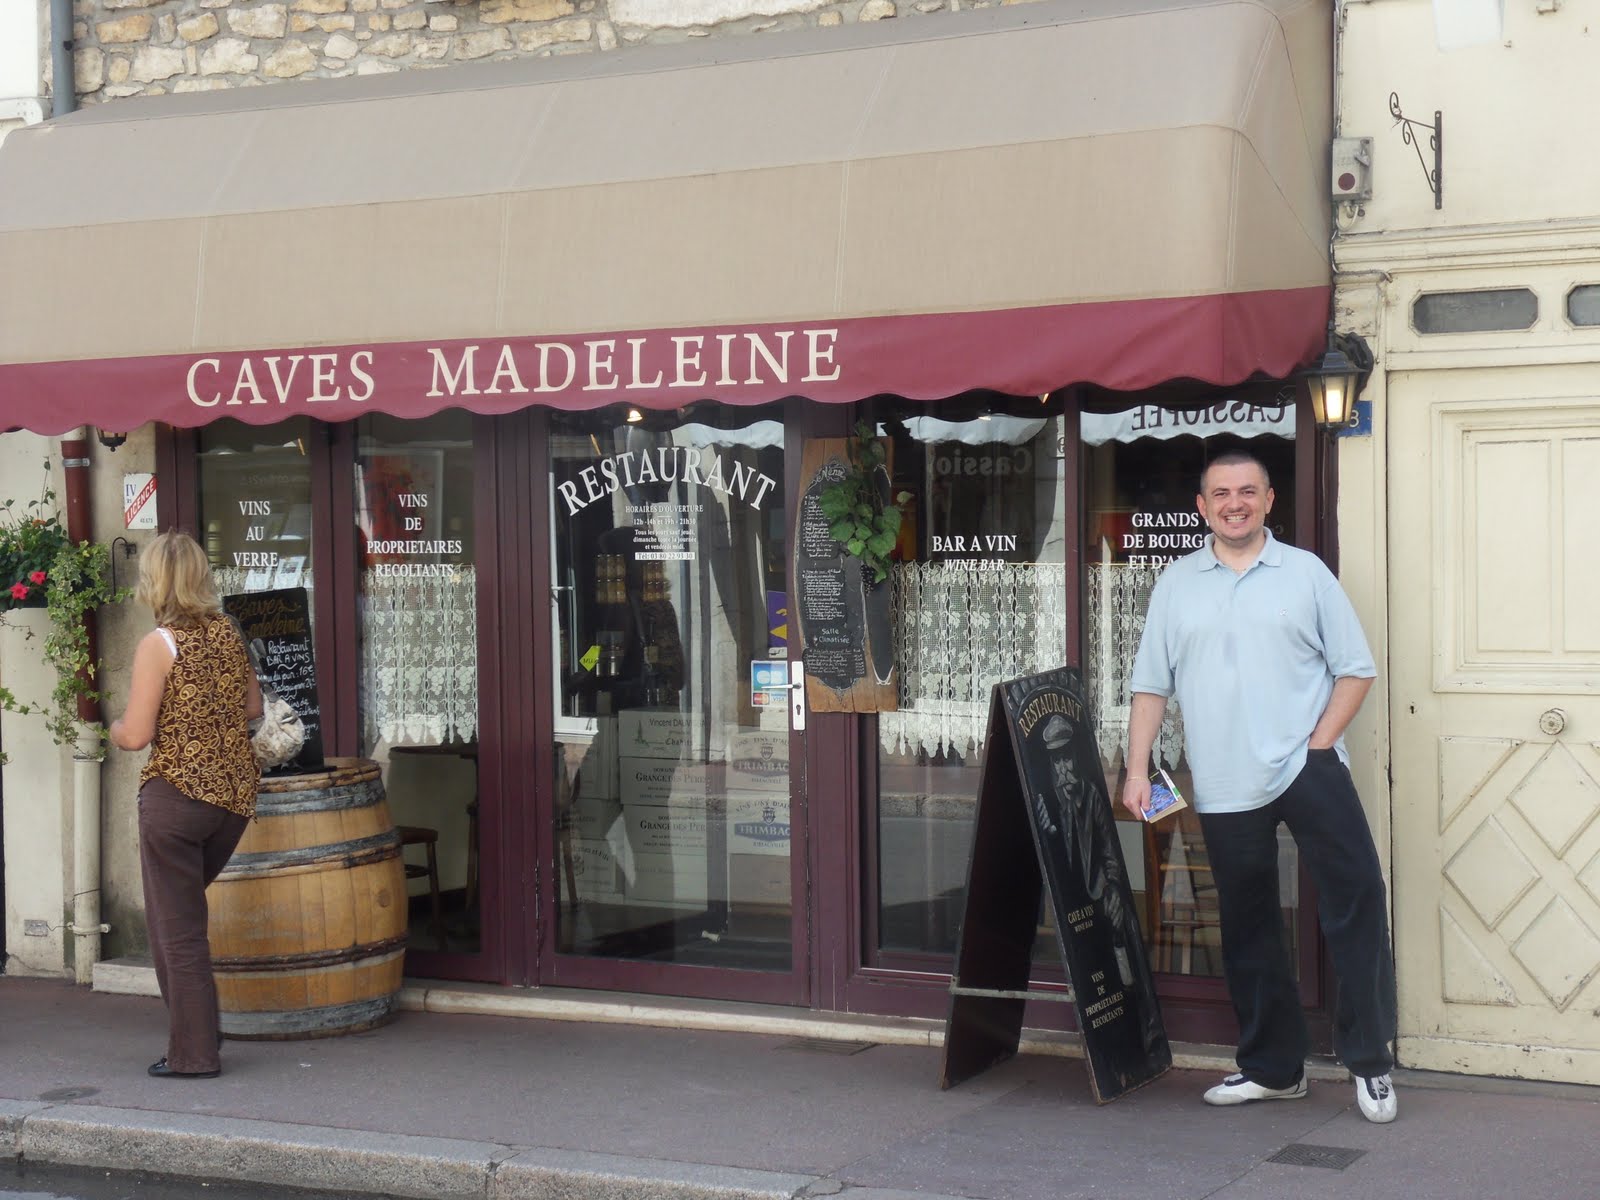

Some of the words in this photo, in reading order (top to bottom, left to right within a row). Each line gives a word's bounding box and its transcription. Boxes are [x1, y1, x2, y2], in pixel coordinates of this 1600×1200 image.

[186, 351, 376, 408] CAVES
[425, 329, 841, 398] MADELEINE
[557, 447, 777, 516] RESTAURANT
[126, 484, 136, 497] IV
[126, 480, 155, 524] LICENCE
[239, 501, 271, 516] VINS
[398, 494, 428, 508] VINS
[625, 505, 658, 513] HORAIRES
[658, 504, 704, 513] D'OUVERTURE
[404, 517, 423, 531] DE
[1131, 512, 1200, 528] GRANDS
[245, 526, 264, 541] AU
[1123, 533, 1145, 549] DE
[1148, 533, 1206, 549] BOURG
[366, 540, 463, 554] PROPRIETAIRES
[932, 535, 966, 552] BAR
[970, 535, 982, 552] A
[985, 534, 1018, 552] VIN
[233, 552, 278, 567] VERRE
[943, 558, 981, 572] WINE
[980, 558, 1005, 571] BAR
[1128, 555, 1148, 570] ET
[1151, 555, 1184, 570] D'A
[374, 563, 454, 577] RECOLTANTS
[244, 615, 306, 639] adeleine
[267, 638, 310, 655] Restaurant
[818, 635, 850, 643] Climatisée
[266, 655, 283, 667] BAR
[1018, 693, 1082, 738] RESTAURANT
[738, 760, 789, 773] TRIMBAC
[635, 772, 667, 783] GRANGE
[640, 820, 671, 831] GRANGE
[740, 824, 790, 836] TRIMBAC
[1067, 909, 1082, 924] CAVE
[1091, 970, 1105, 983] VINS
[1097, 985, 1106, 996] DE
[1085, 991, 1124, 1017] PROPRIETAIRES
[1091, 1006, 1124, 1029] RECOLTANTS
